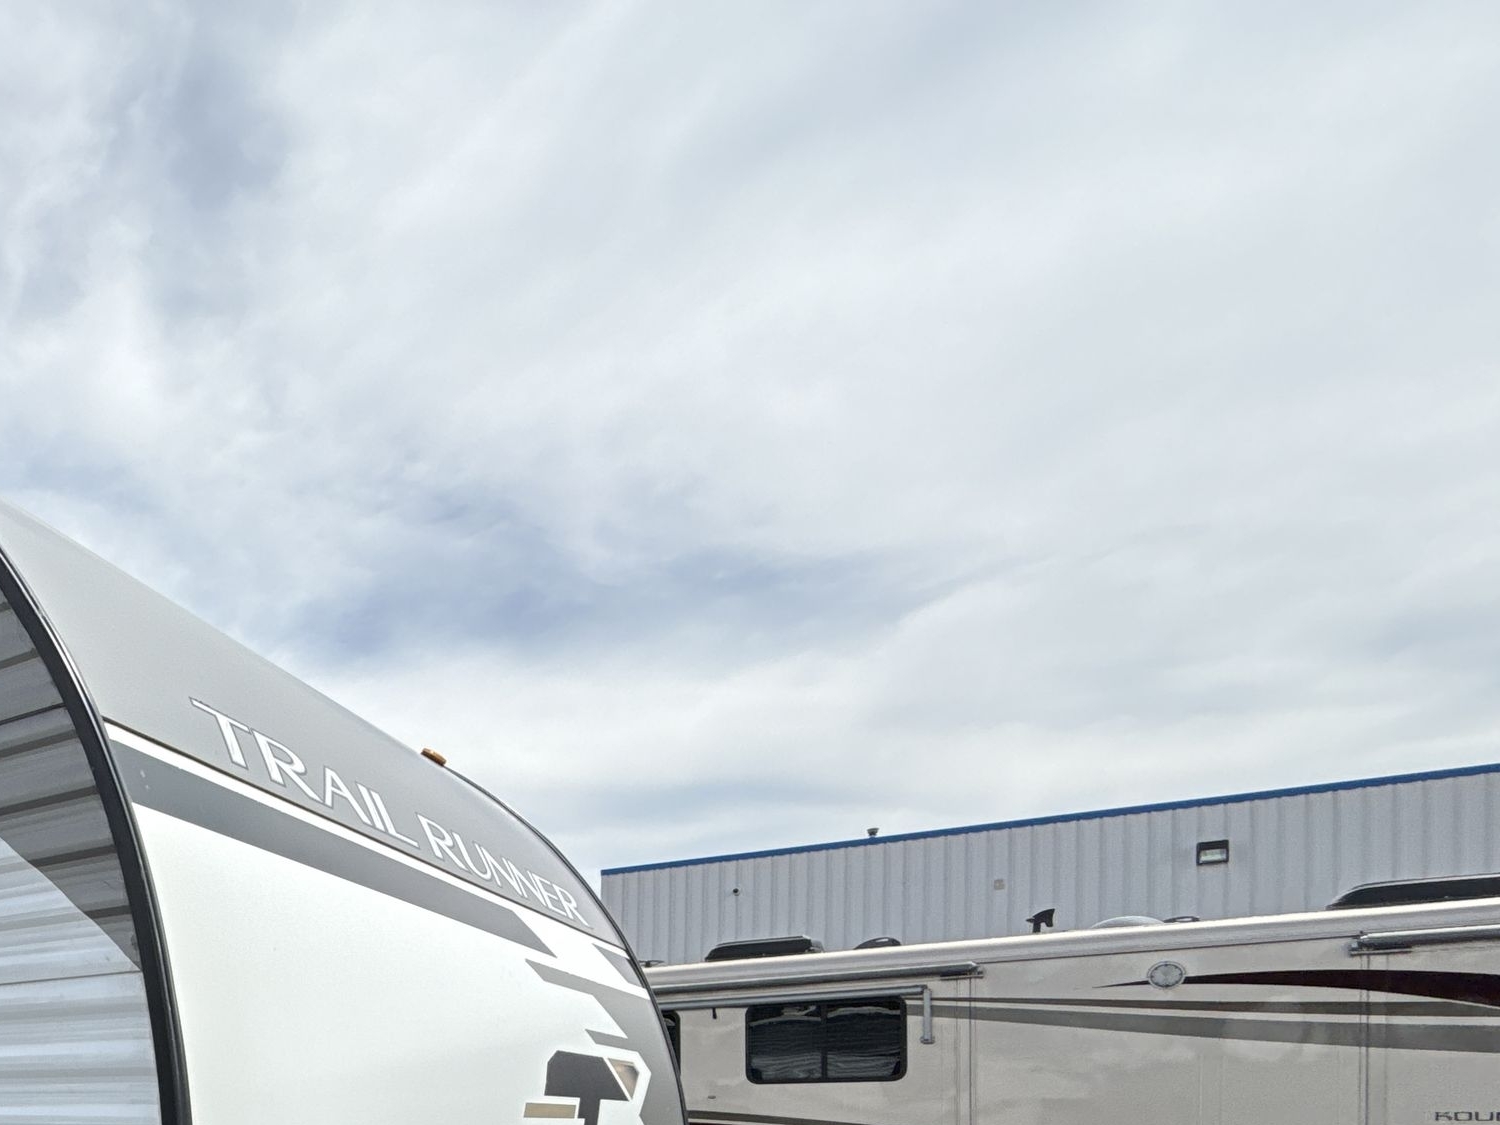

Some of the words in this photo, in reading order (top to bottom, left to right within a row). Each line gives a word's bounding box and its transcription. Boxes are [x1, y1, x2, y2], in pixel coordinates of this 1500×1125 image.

[189, 697, 420, 849] TRAIL
[415, 812, 595, 929] RUNNER
[1434, 1111, 1500, 1121] KOU
